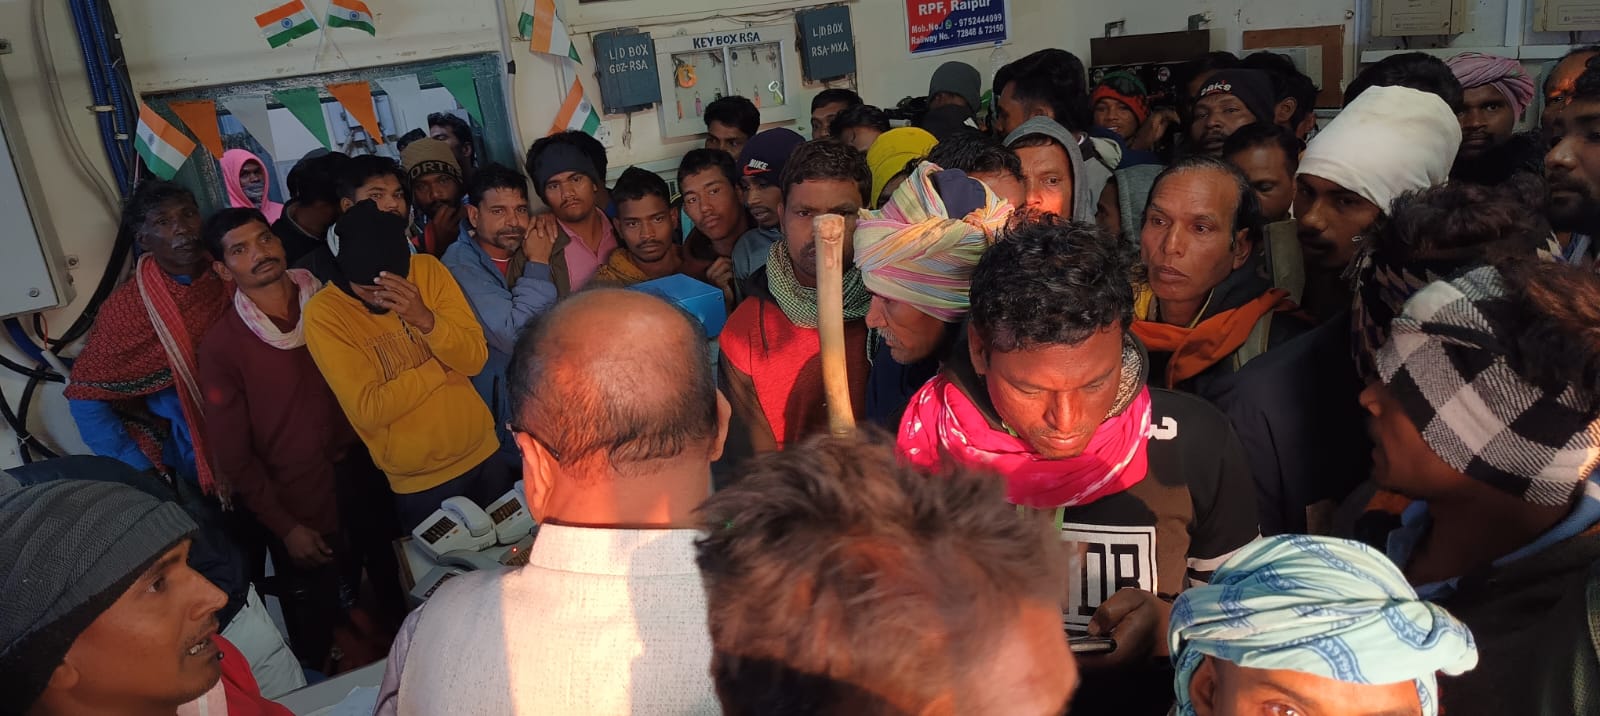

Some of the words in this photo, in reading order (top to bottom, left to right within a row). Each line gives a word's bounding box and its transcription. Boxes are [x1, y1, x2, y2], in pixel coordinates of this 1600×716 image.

[918, 2, 947, 16] RPF,
[950, 0, 990, 12] Raipur
[958, 13, 1003, 27] 9752444099
[956, 28, 977, 38] 72848
[984, 24, 1004, 34] 72150
[692, 36, 714, 49] KEY
[715, 33, 738, 45] BOX
[739, 31, 761, 43] RSA
[628, 44, 649, 57] BOX
[811, 41, 849, 57] RSA-MXA
[748, 158, 769, 170] NIKE
